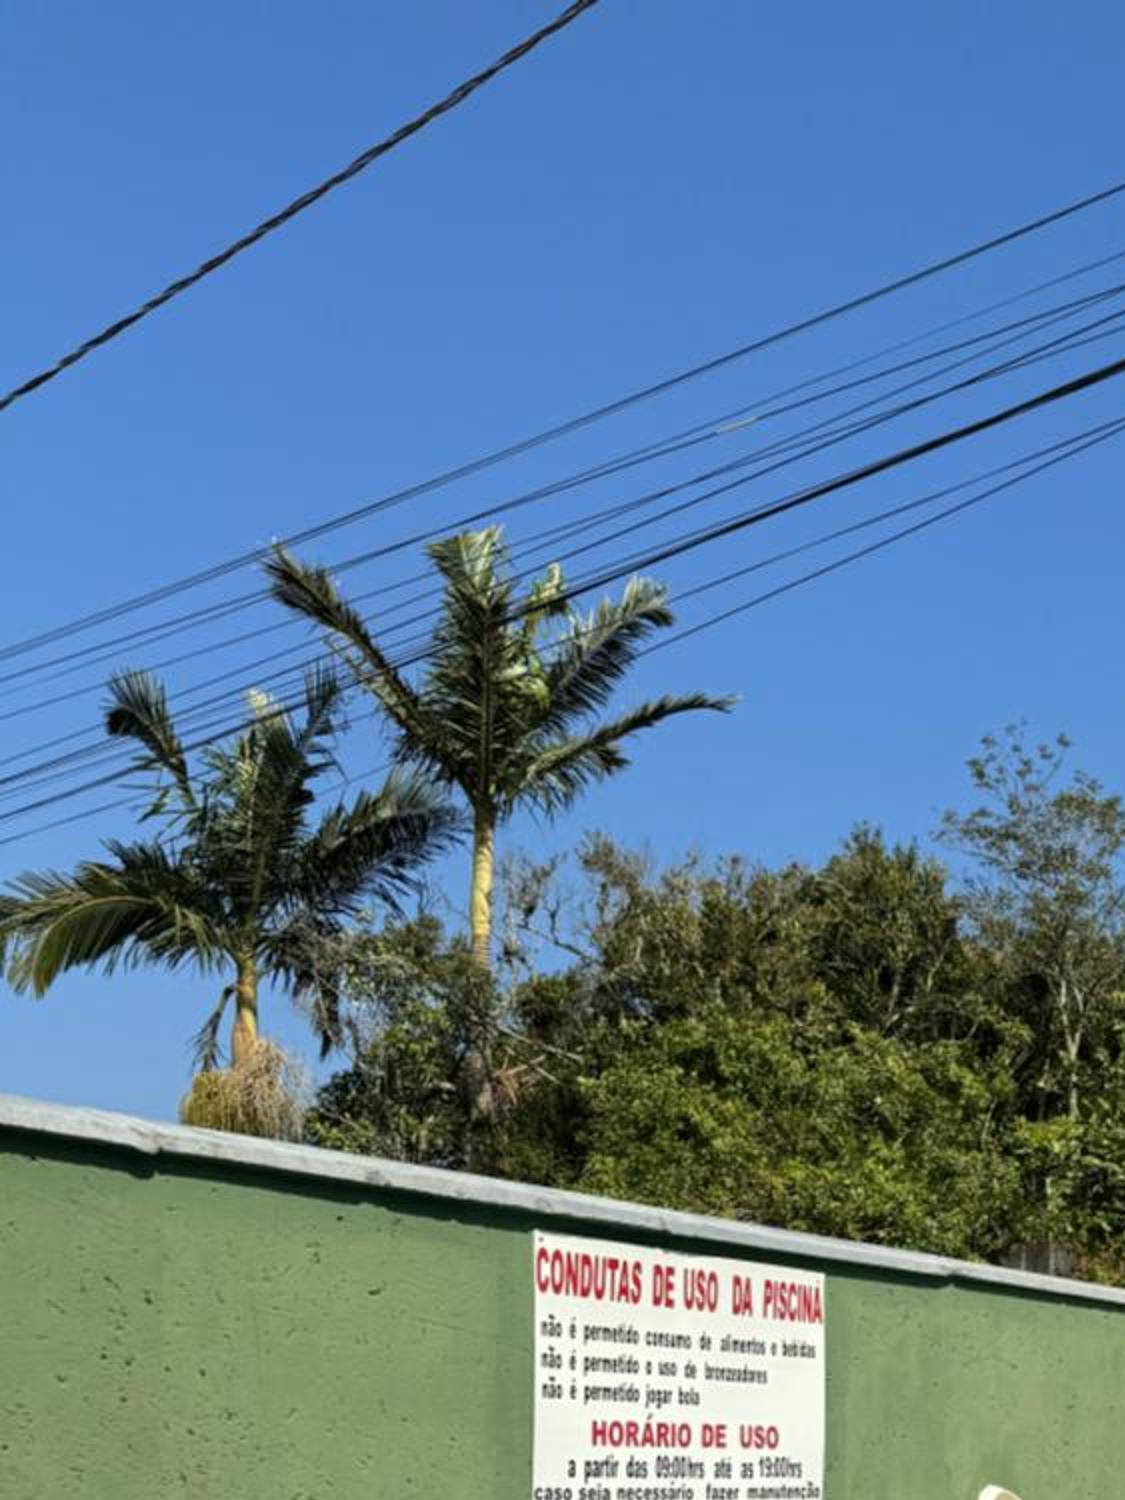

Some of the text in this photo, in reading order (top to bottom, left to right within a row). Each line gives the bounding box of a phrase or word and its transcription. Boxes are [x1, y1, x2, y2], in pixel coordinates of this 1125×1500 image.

[537, 1247, 823, 1324] CONDUTAS DE USO DA PISCINA
[541, 1314, 562, 1338] não
[569, 1316, 577, 1339] é
[646, 1331, 692, 1350] consumo
[700, 1331, 711, 1351] de
[720, 1333, 766, 1356] alimentos
[771, 1342, 777, 1356] e
[782, 1339, 816, 1359] bebidas
[541, 1345, 562, 1369] não
[569, 1348, 577, 1371] é
[646, 1361, 653, 1375] o
[658, 1361, 677, 1376] uso
[684, 1360, 697, 1379] de
[704, 1362, 768, 1384] bronzeadores
[542, 1376, 562, 1399] não
[569, 1378, 577, 1400] é
[645, 1383, 672, 1409] jogar
[678, 1385, 700, 1405] bola
[592, 1413, 779, 1449] HORÁRIO DE USO
[568, 1459, 576, 1478] a
[584, 1454, 619, 1484] partir
[626, 1455, 648, 1479] das
[714, 1456, 732, 1479] até
[741, 1461, 753, 1479] as
[534, 1487, 572, 1500] caso
[617, 1480, 694, 1500] necessário
[706, 1483, 739, 1500] fazer
